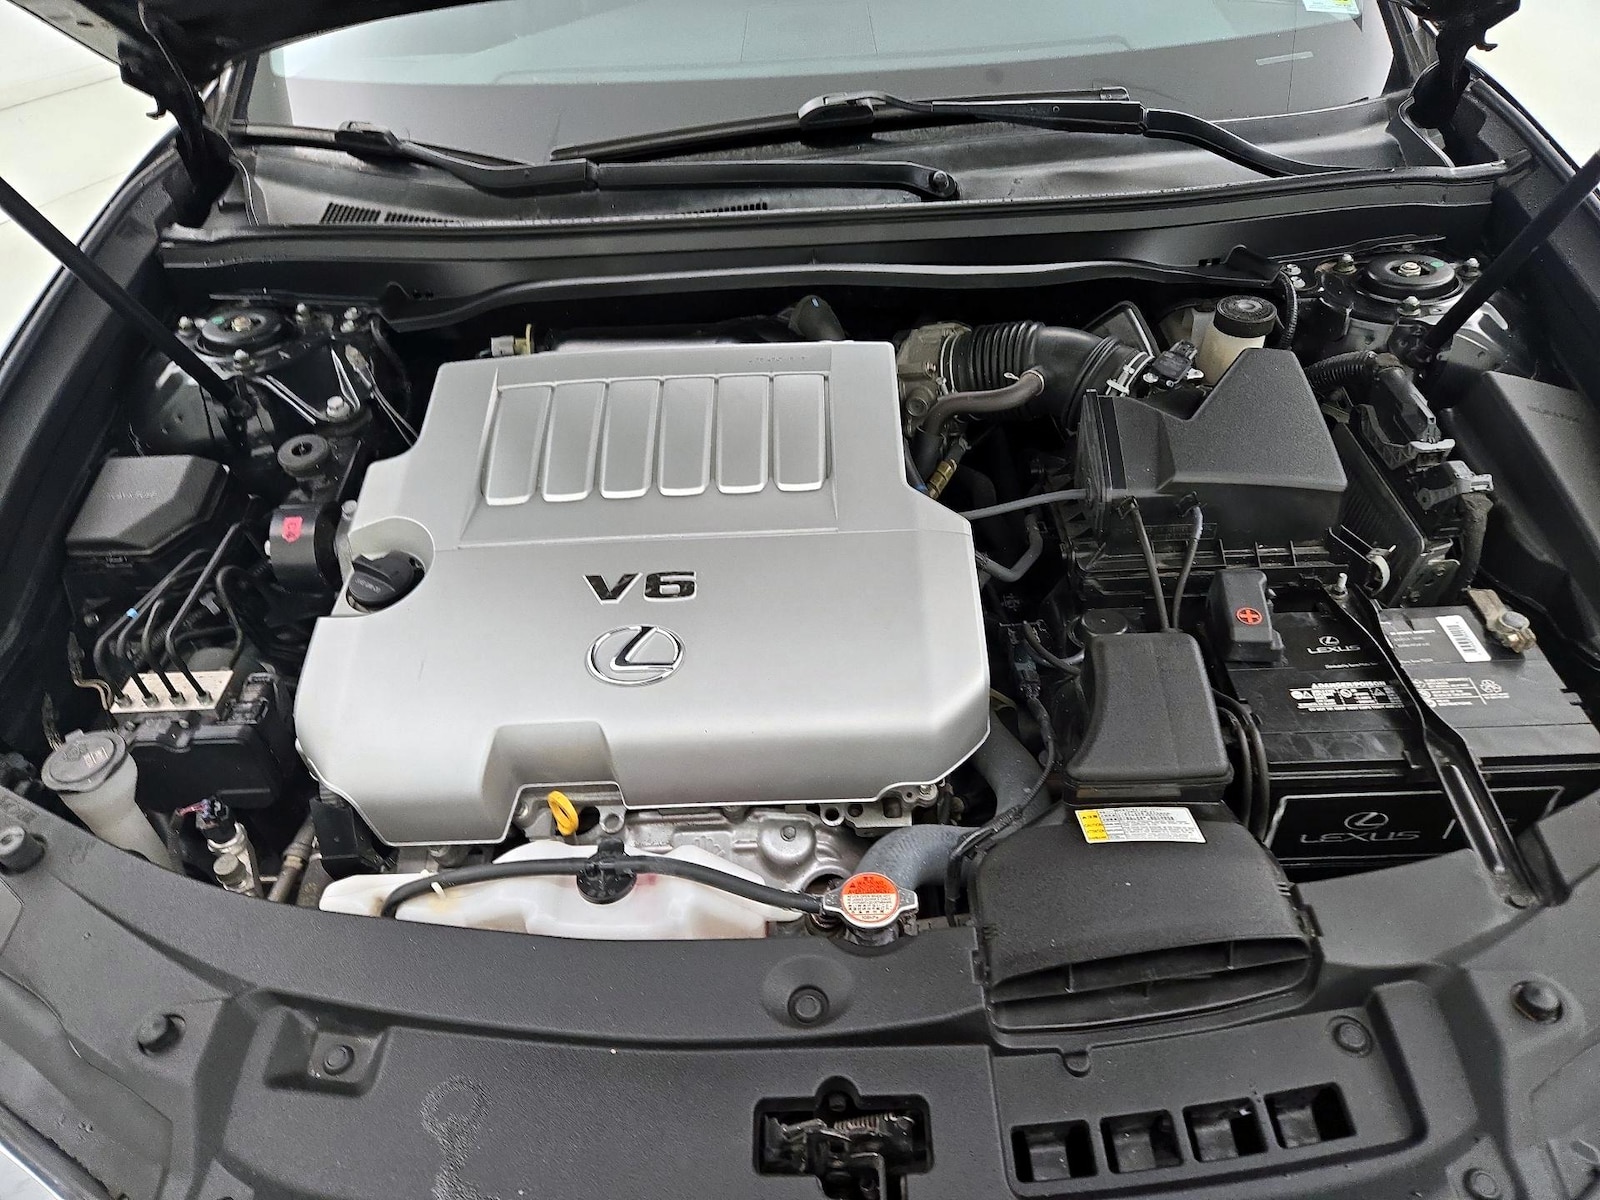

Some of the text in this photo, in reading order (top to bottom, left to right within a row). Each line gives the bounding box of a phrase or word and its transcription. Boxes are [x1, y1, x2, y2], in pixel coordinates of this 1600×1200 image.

[582, 571, 697, 605] V6
[1306, 645, 1361, 655] LEXUS
[1299, 830, 1422, 844] LEXUS
